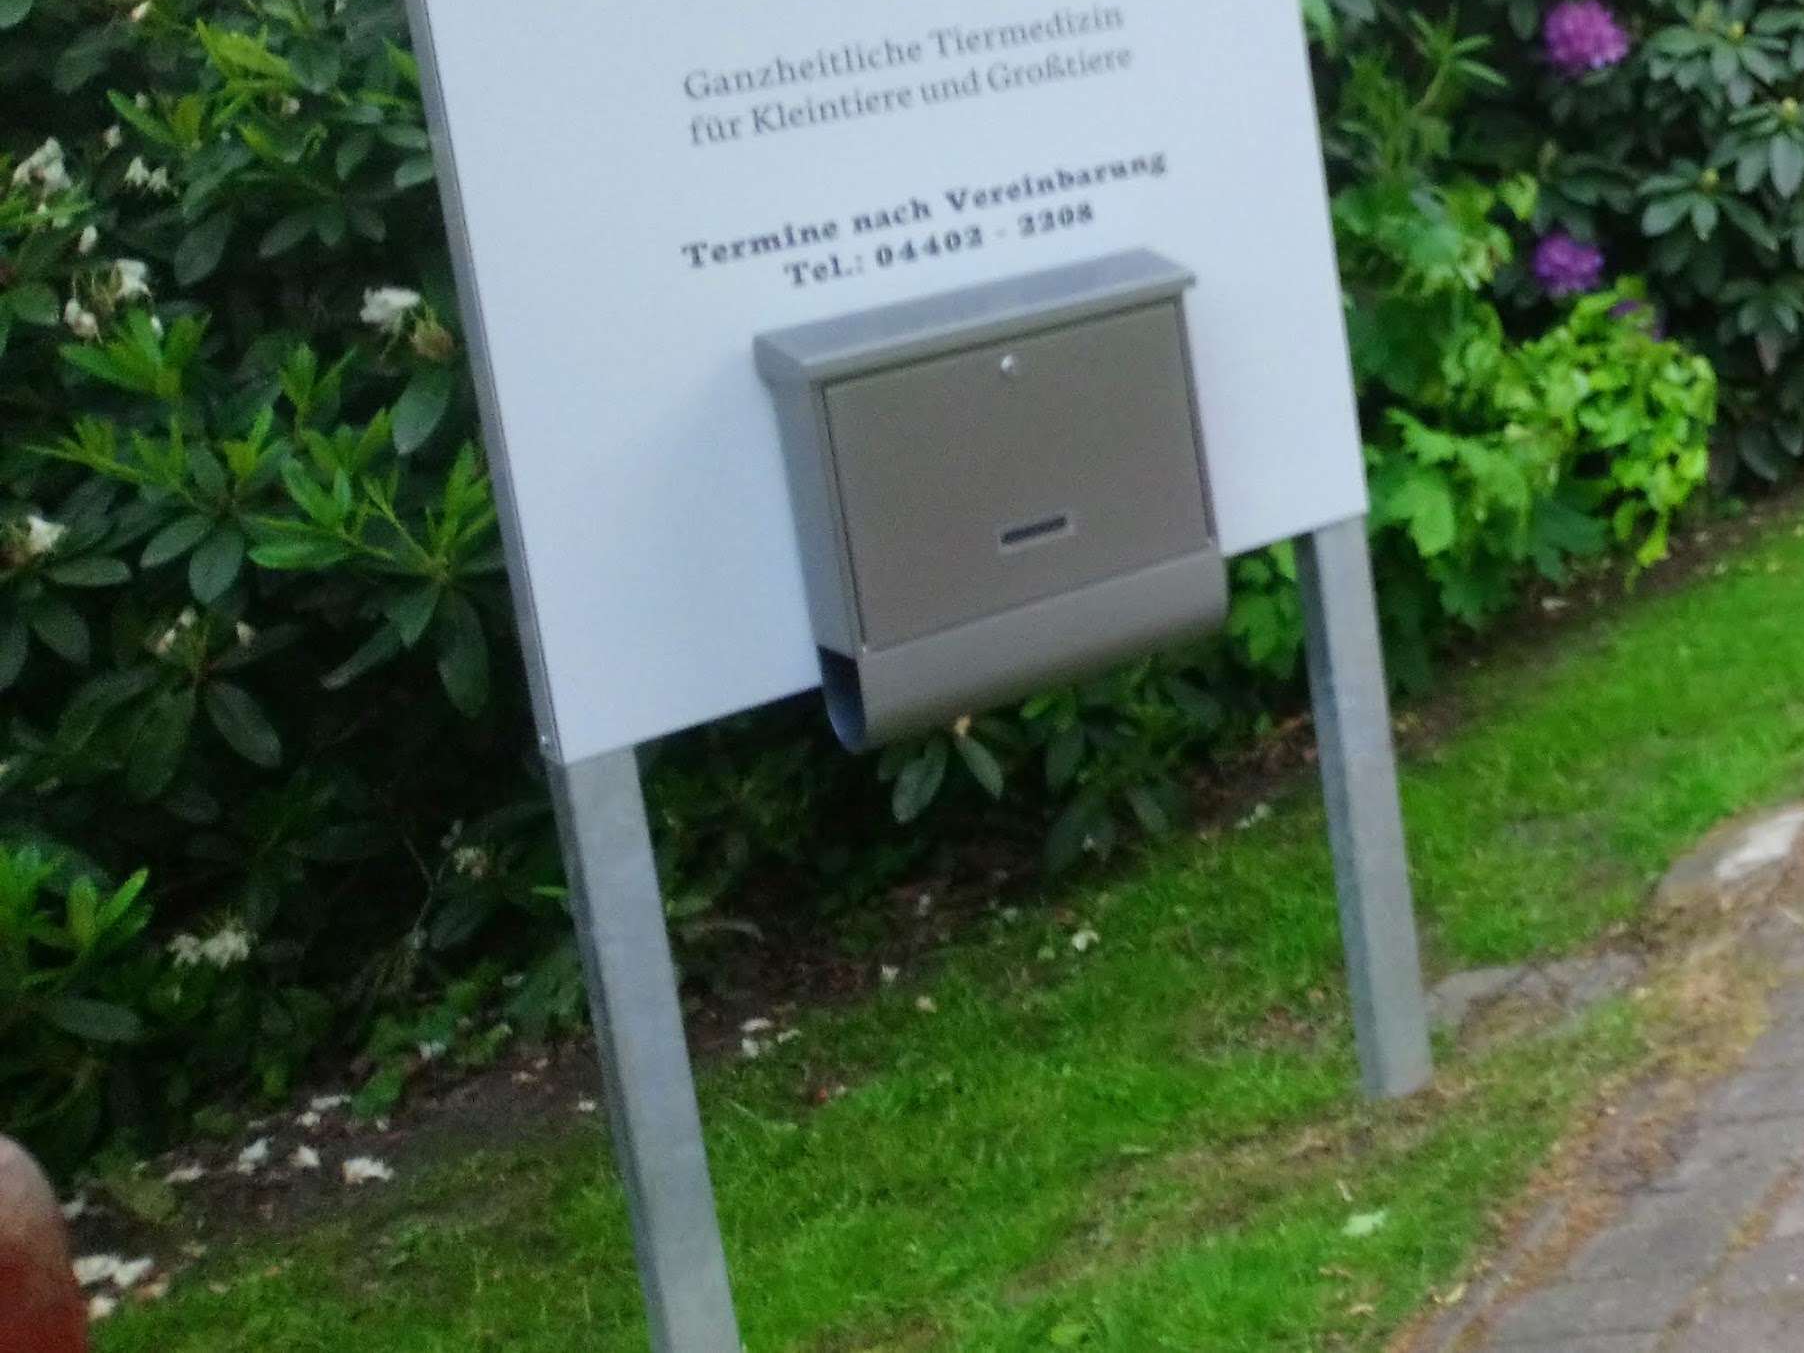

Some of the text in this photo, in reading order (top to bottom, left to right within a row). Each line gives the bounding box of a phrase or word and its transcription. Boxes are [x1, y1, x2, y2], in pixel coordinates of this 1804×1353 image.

[682, 1, 1125, 101] Ganzheitliche Tiermedizin
[687, 45, 1132, 148] für Kleintiere und Großtiere
[682, 149, 1168, 268] Termine nach Vereinbarung
